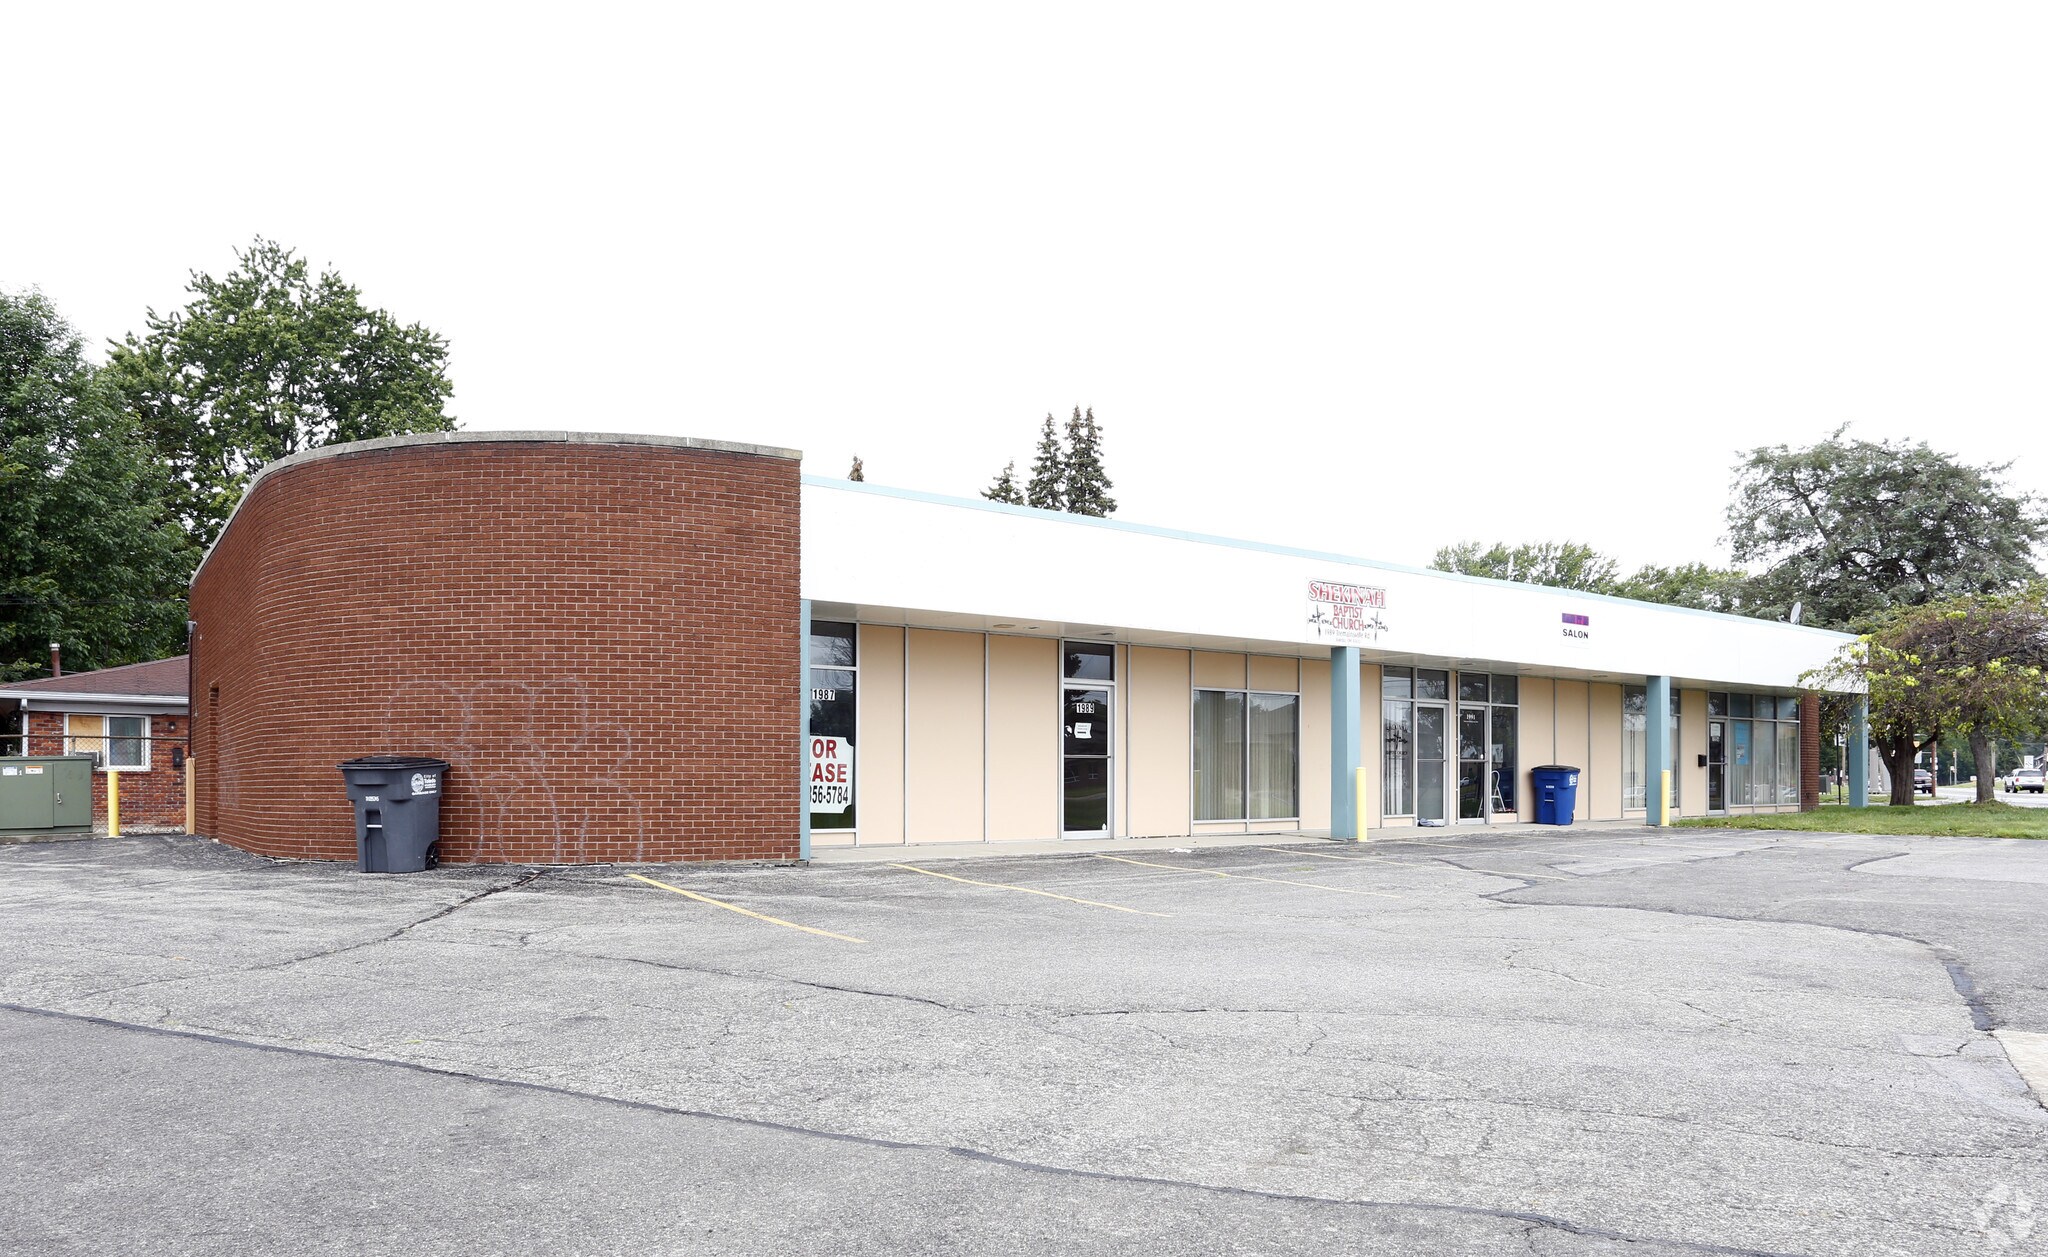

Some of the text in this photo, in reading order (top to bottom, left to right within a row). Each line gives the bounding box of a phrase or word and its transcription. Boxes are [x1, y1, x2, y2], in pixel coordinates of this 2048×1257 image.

[1308, 580, 1386, 609] SHEKINAH
[1333, 604, 1363, 619] BAPTIST
[1332, 617, 1364, 631] CHURCH
[1562, 628, 1589, 639] SALON
[813, 689, 835, 700] 1987
[1077, 703, 1094, 713] 1989
[810, 738, 837, 759] OR
[810, 763, 848, 783] ASE
